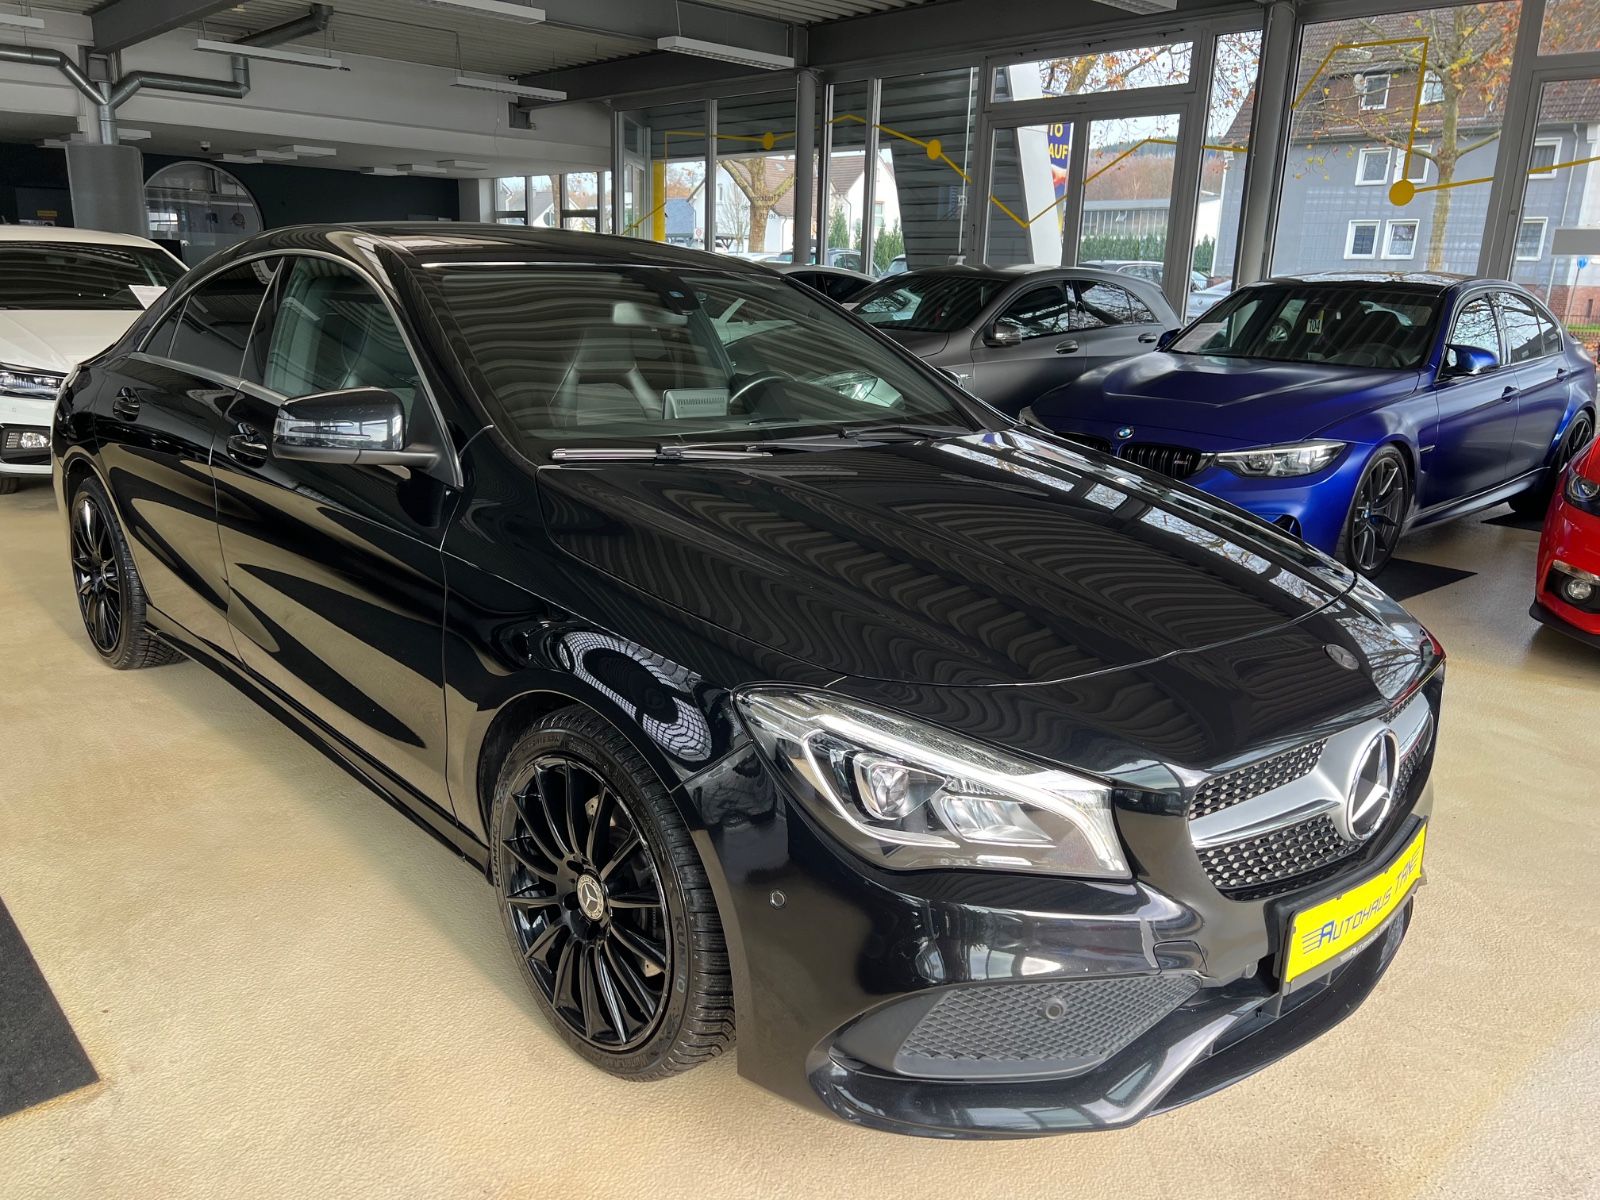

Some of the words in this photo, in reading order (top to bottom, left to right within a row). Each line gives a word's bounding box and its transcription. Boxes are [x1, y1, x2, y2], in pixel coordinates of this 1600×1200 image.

[1049, 124, 1063, 137] TO
[1049, 143, 1069, 160] AUF
[1318, 886, 1392, 949] AUTOHAUS
